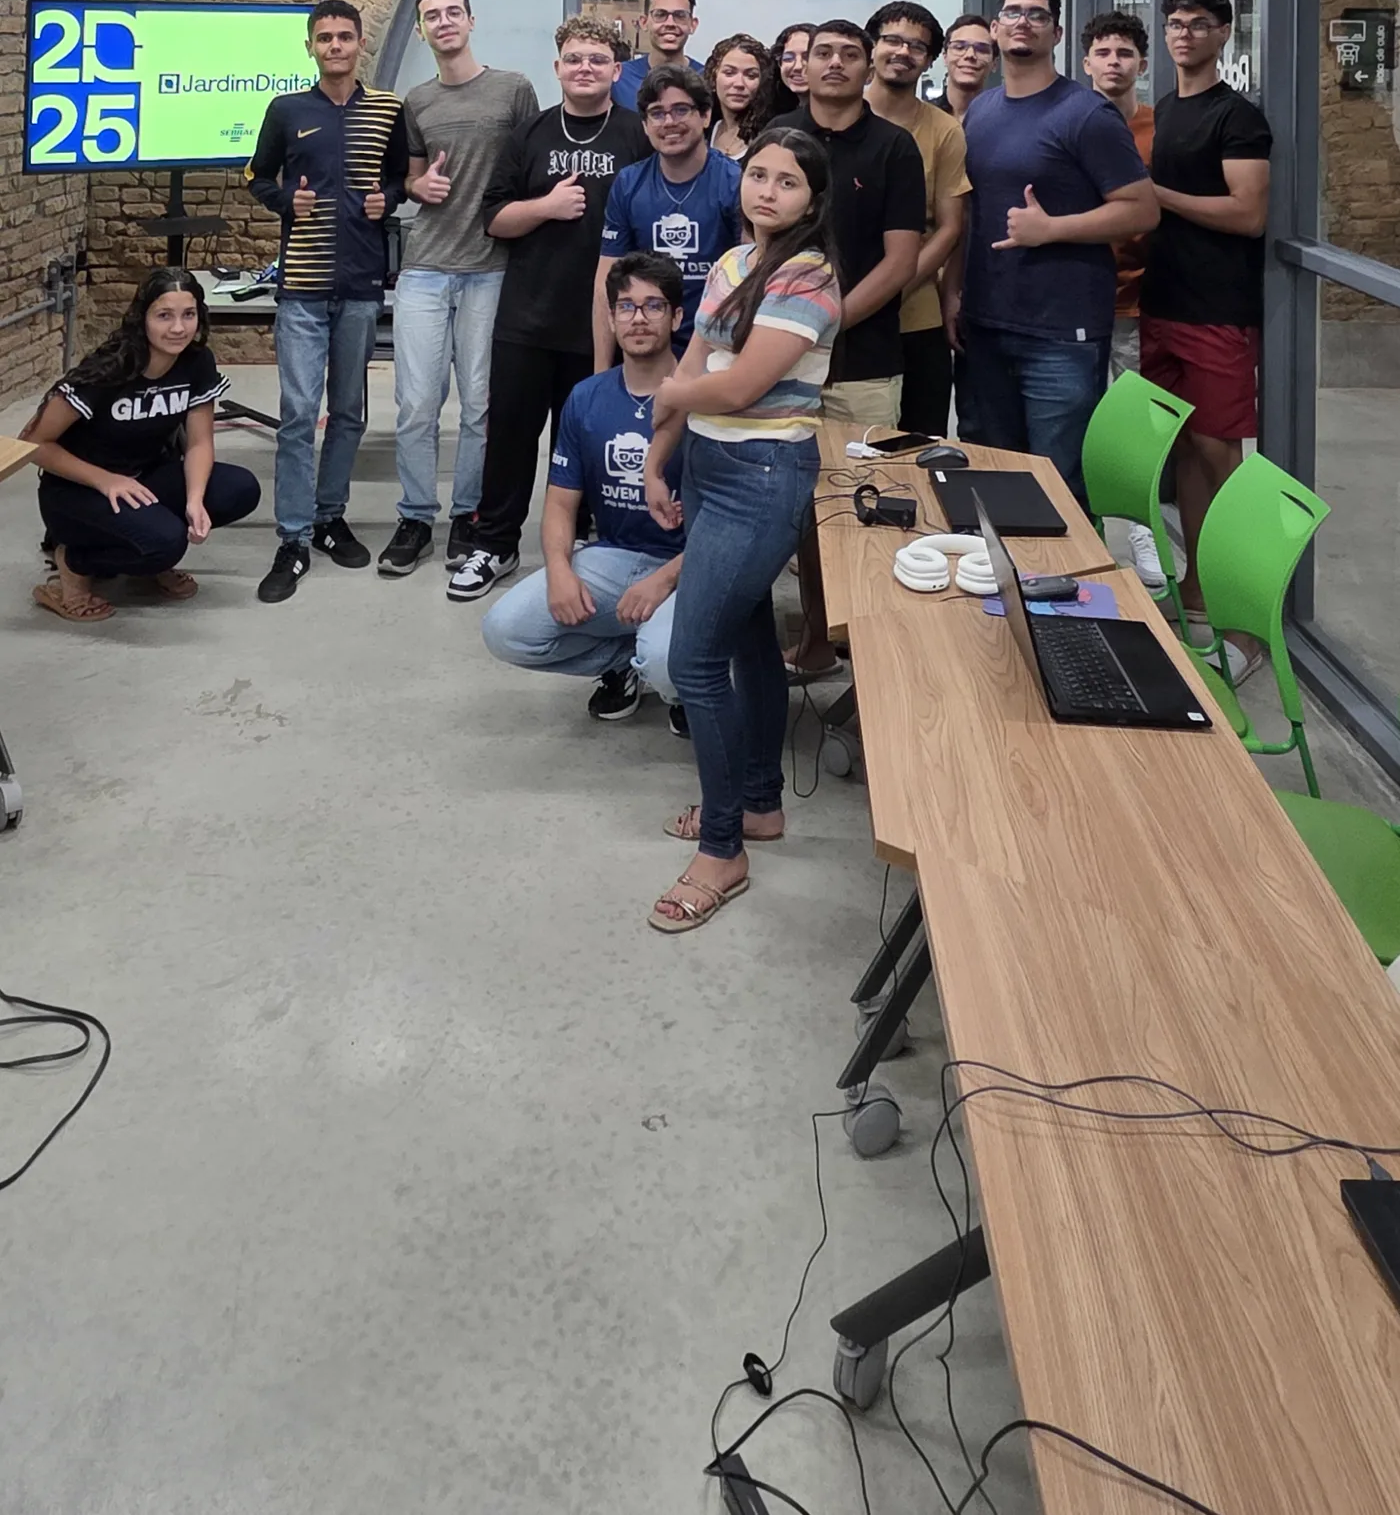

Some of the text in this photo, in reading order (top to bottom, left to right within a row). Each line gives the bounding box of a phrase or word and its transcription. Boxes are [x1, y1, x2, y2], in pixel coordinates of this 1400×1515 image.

[1375, 48, 1385, 62] de
[30, 94, 136, 164] 25
[111, 390, 190, 421] GLAM
